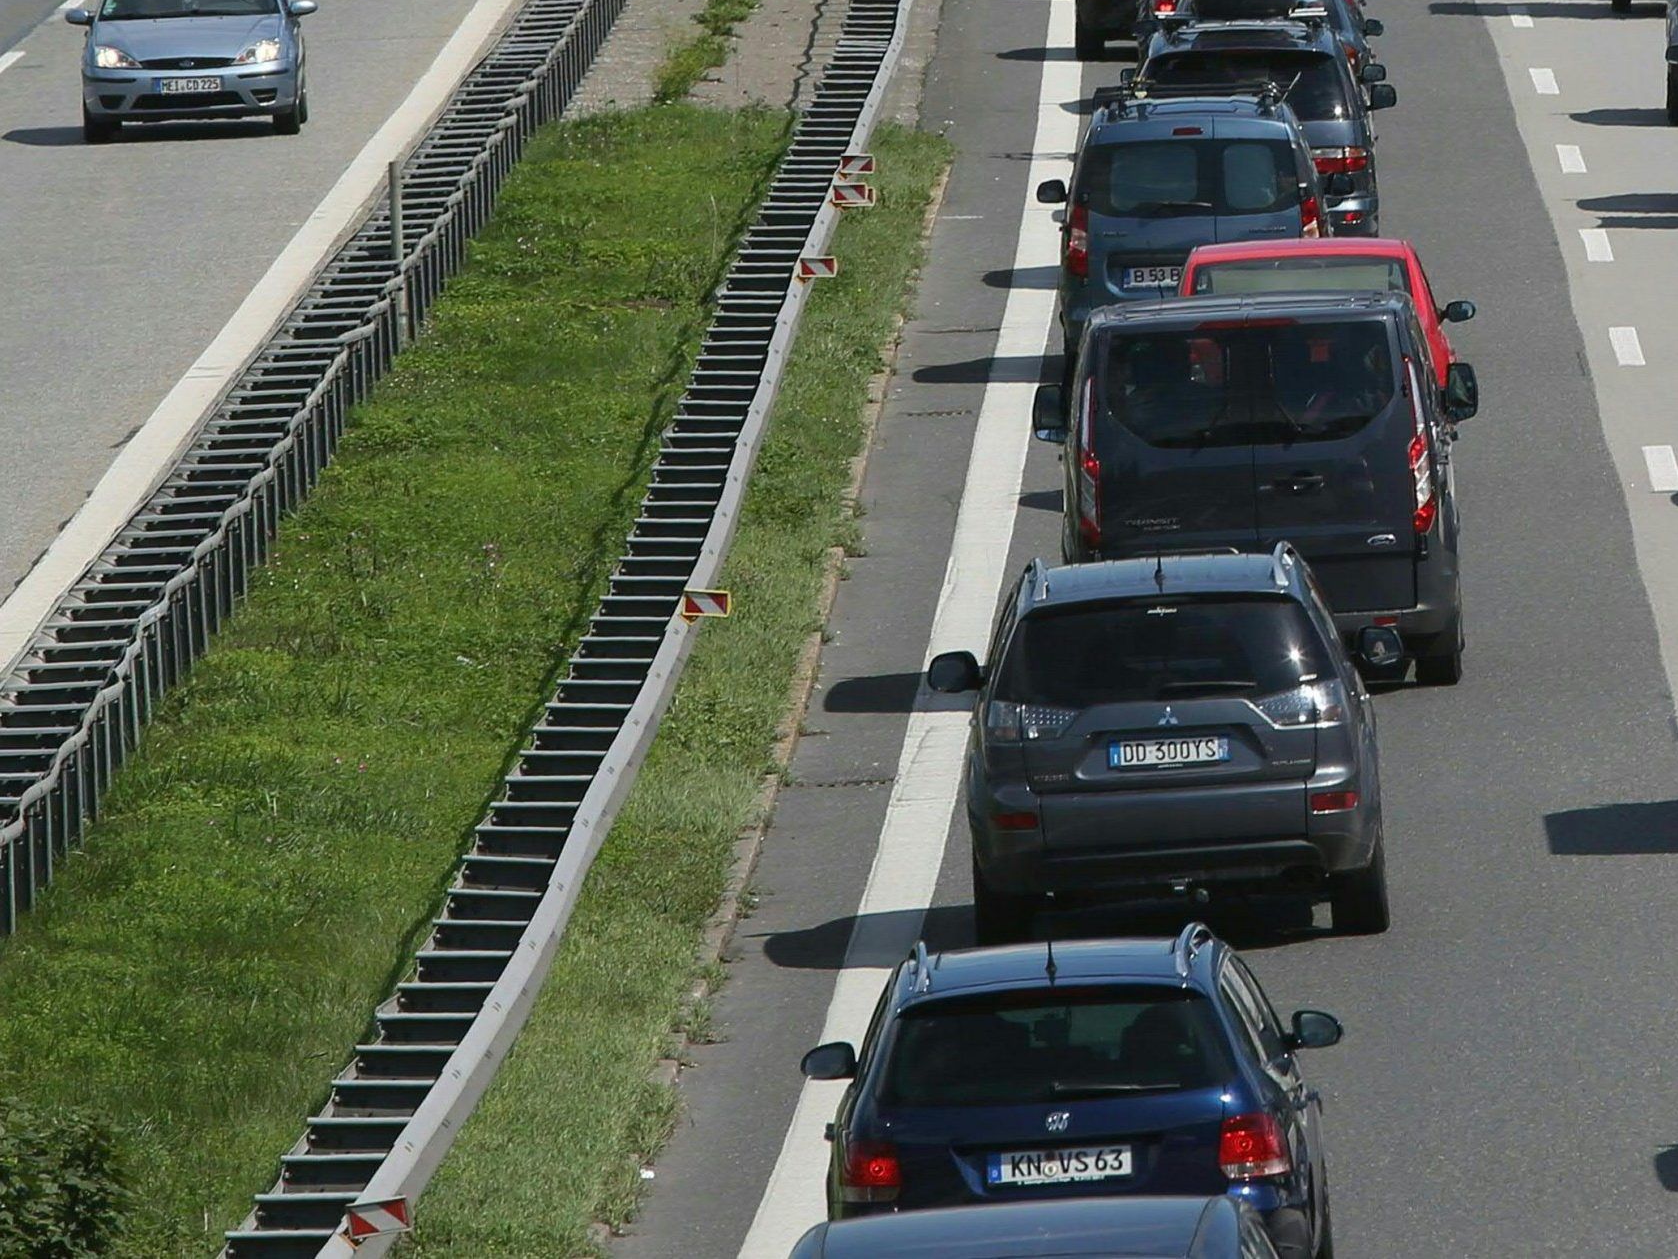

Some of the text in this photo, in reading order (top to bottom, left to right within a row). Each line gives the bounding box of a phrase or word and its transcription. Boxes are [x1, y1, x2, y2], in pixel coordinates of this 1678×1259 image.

[200, 79, 219, 90] 225
[1134, 269, 1144, 283] B
[1149, 268, 1166, 282] 53
[1123, 742, 1146, 763] DD
[1154, 738, 1217, 761] 300YS
[1010, 1153, 1042, 1178] KN
[1058, 1151, 1090, 1173] VS
[1094, 1148, 1123, 1171] 63
